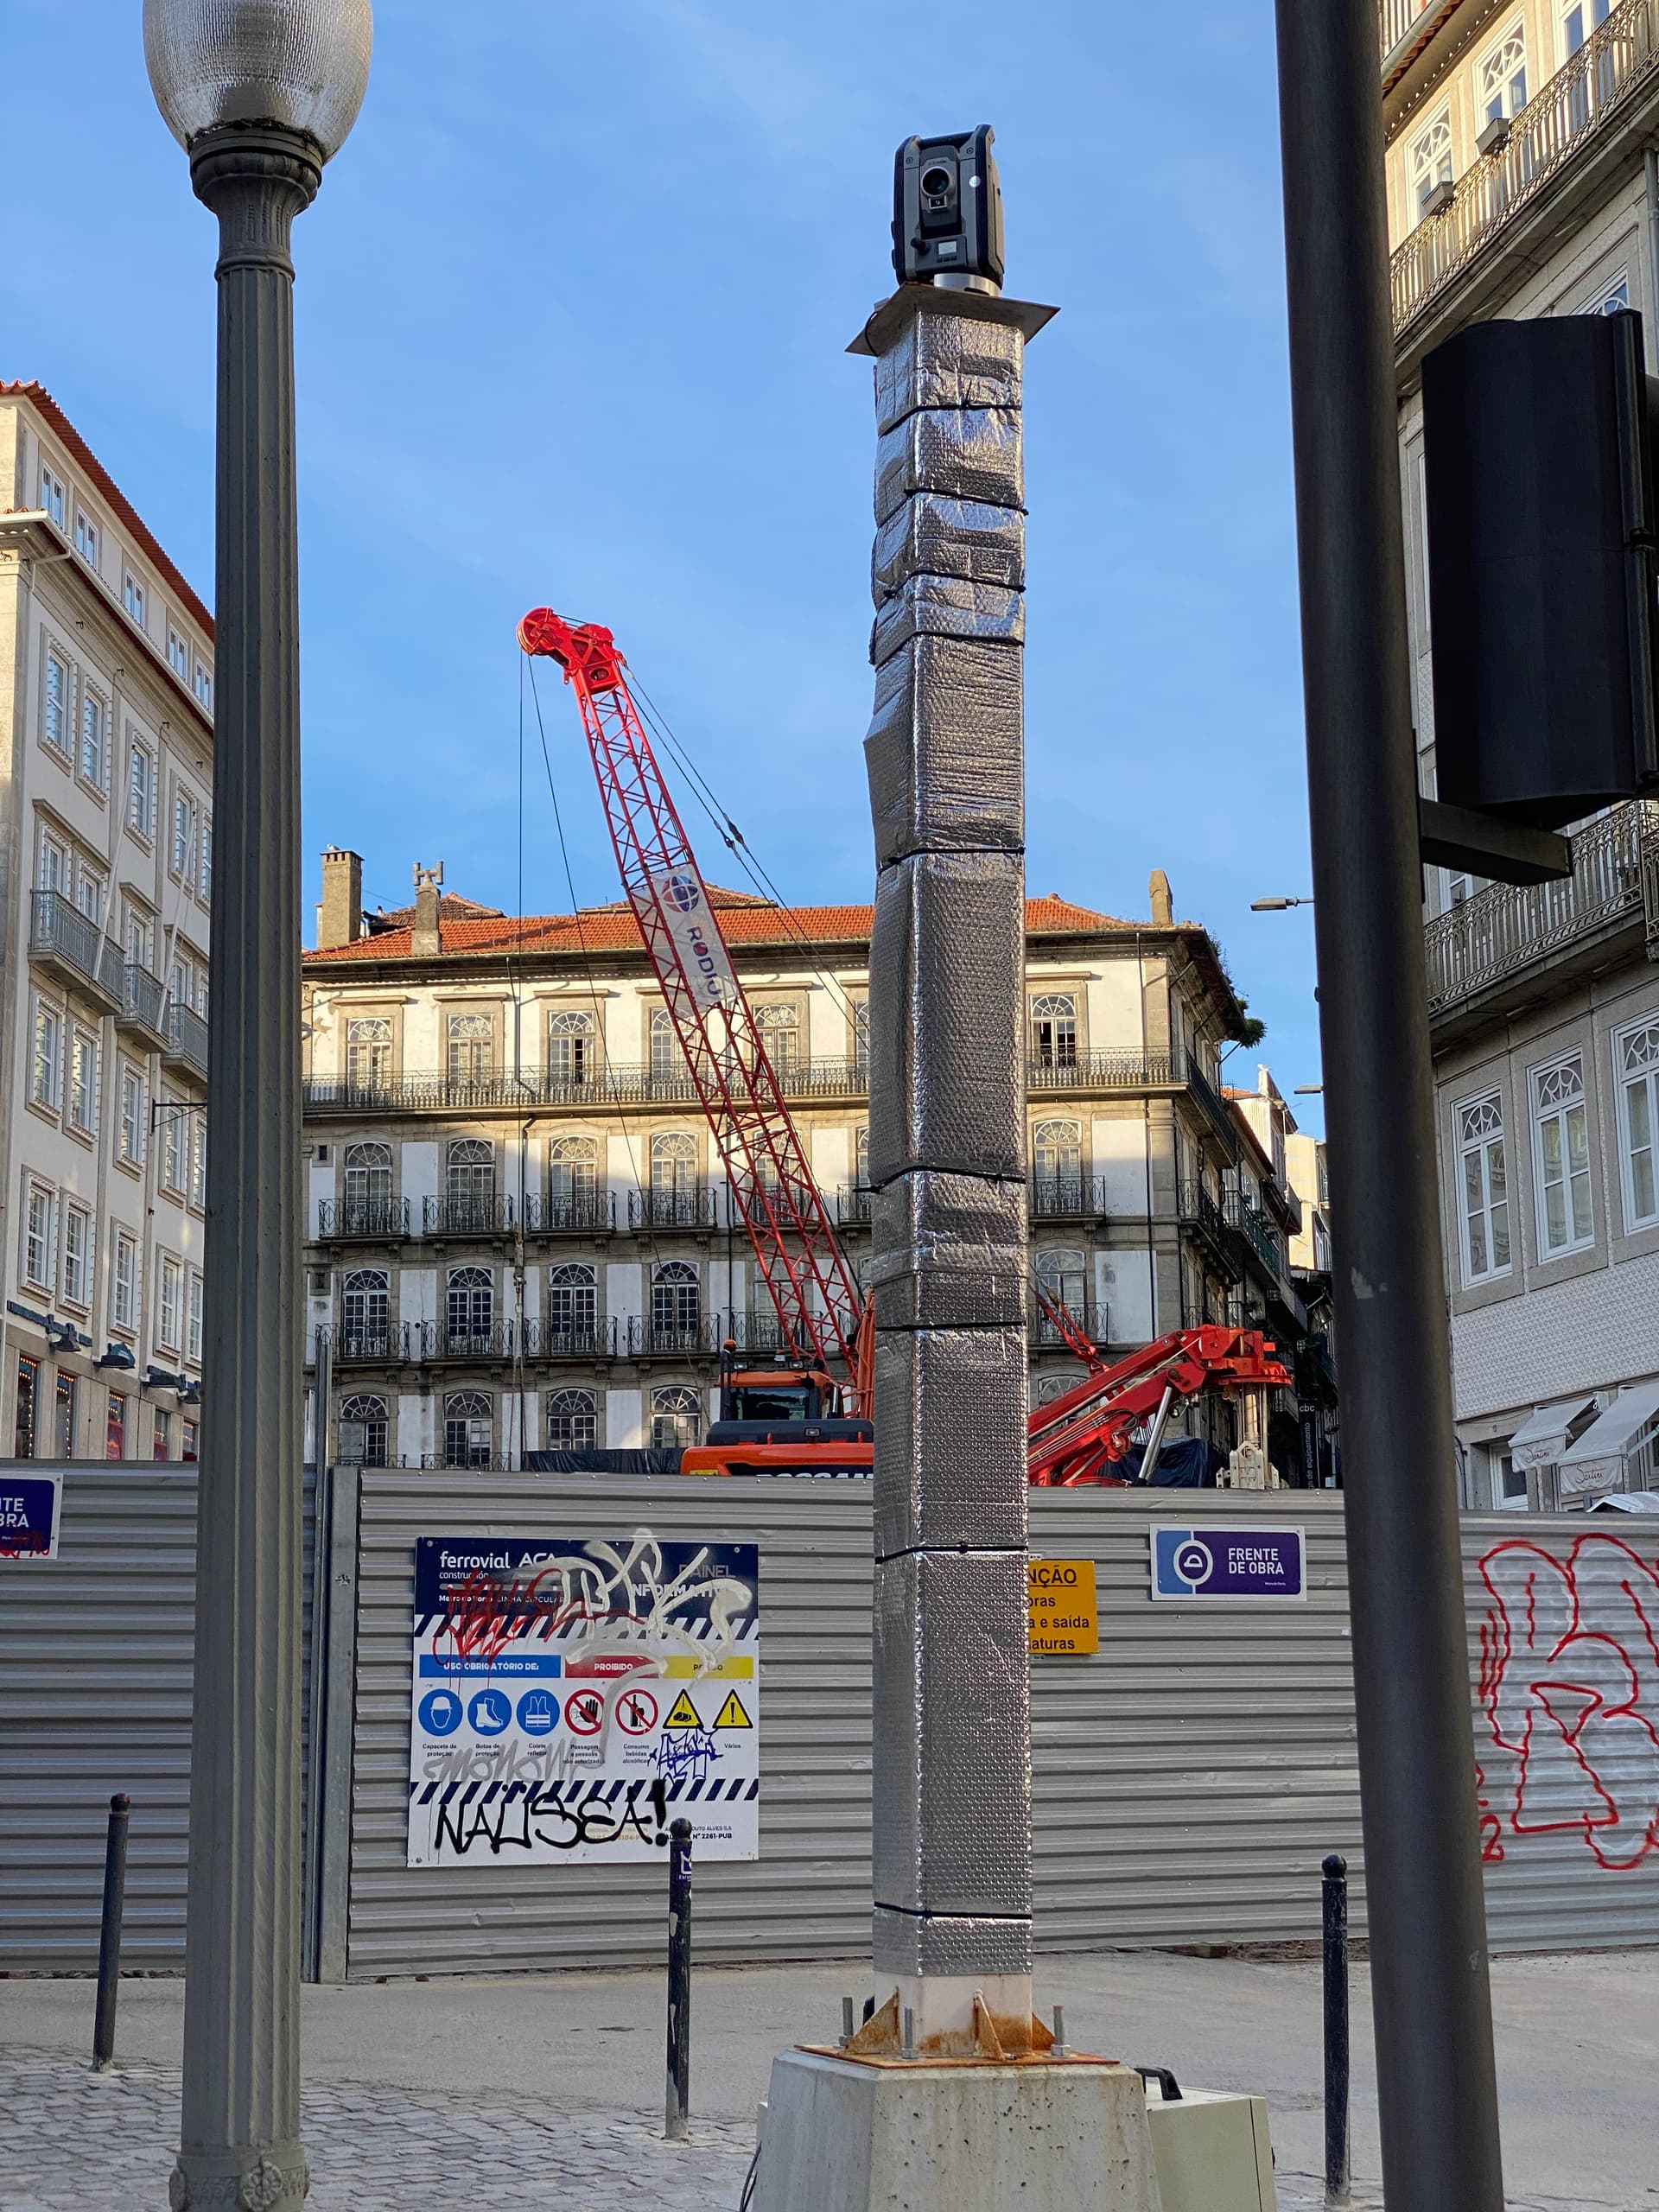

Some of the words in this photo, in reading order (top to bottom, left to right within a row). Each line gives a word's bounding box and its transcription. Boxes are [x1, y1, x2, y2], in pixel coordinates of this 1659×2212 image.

[1300, 1403, 1314, 1412] cbc
[439, 1551, 511, 1568] ferrovial
[1228, 1548, 1279, 1560] FRENTE
[1229, 1561, 1245, 1573] DE
[1249, 1561, 1285, 1574] OBRA
[1029, 1565, 1077, 1588] NÇÃO
[1040, 1618, 1048, 1628] e
[1052, 1615, 1090, 1629] saída
